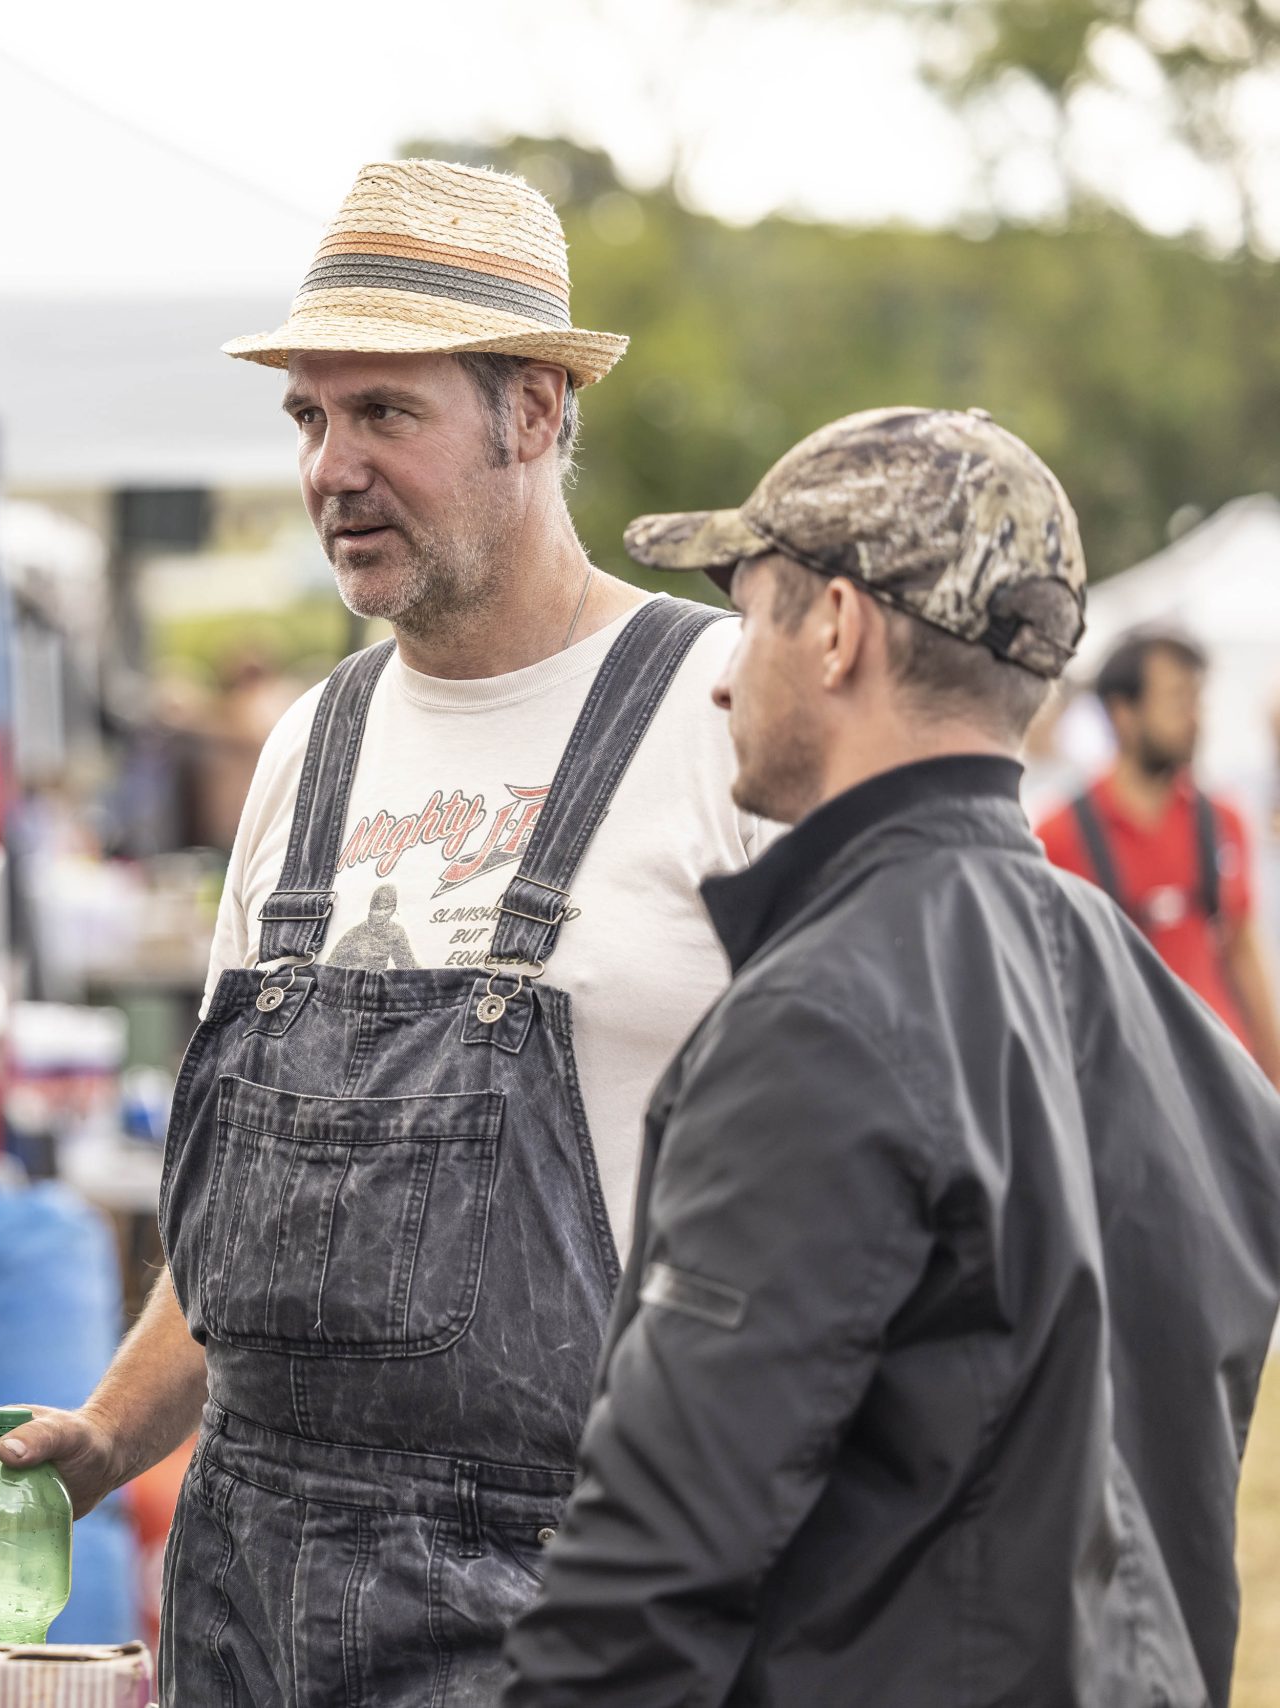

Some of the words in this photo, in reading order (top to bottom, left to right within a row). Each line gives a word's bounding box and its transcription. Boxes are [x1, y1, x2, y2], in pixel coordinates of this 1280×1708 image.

[337, 789, 487, 877] Mighty
[429, 907, 499, 924] SLAVISHL
[448, 927, 490, 944] BUT
